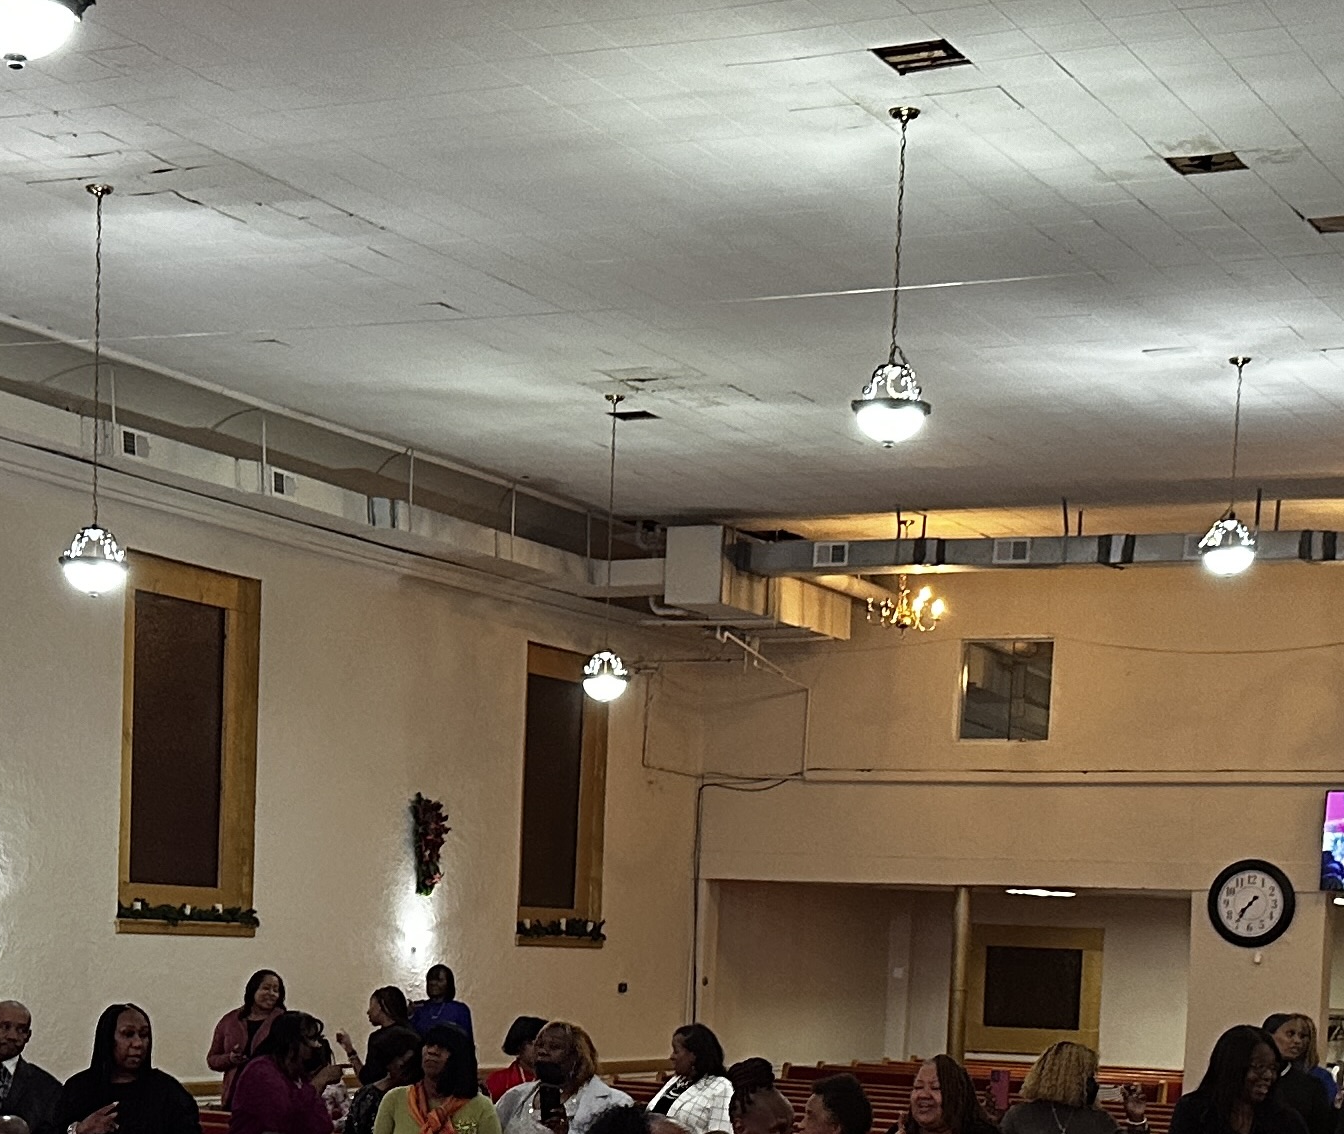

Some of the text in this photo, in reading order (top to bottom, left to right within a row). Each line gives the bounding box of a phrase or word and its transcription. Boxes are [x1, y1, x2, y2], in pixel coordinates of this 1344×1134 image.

[1236, 877, 1244, 888] 11
[1248, 875, 1258, 885] 12
[1226, 886, 1236, 897] 10
[1269, 885, 1276, 897] 2
[1271, 899, 1278, 909] 3
[1246, 922, 1253, 932] 6
[1258, 920, 1265, 930] 5
